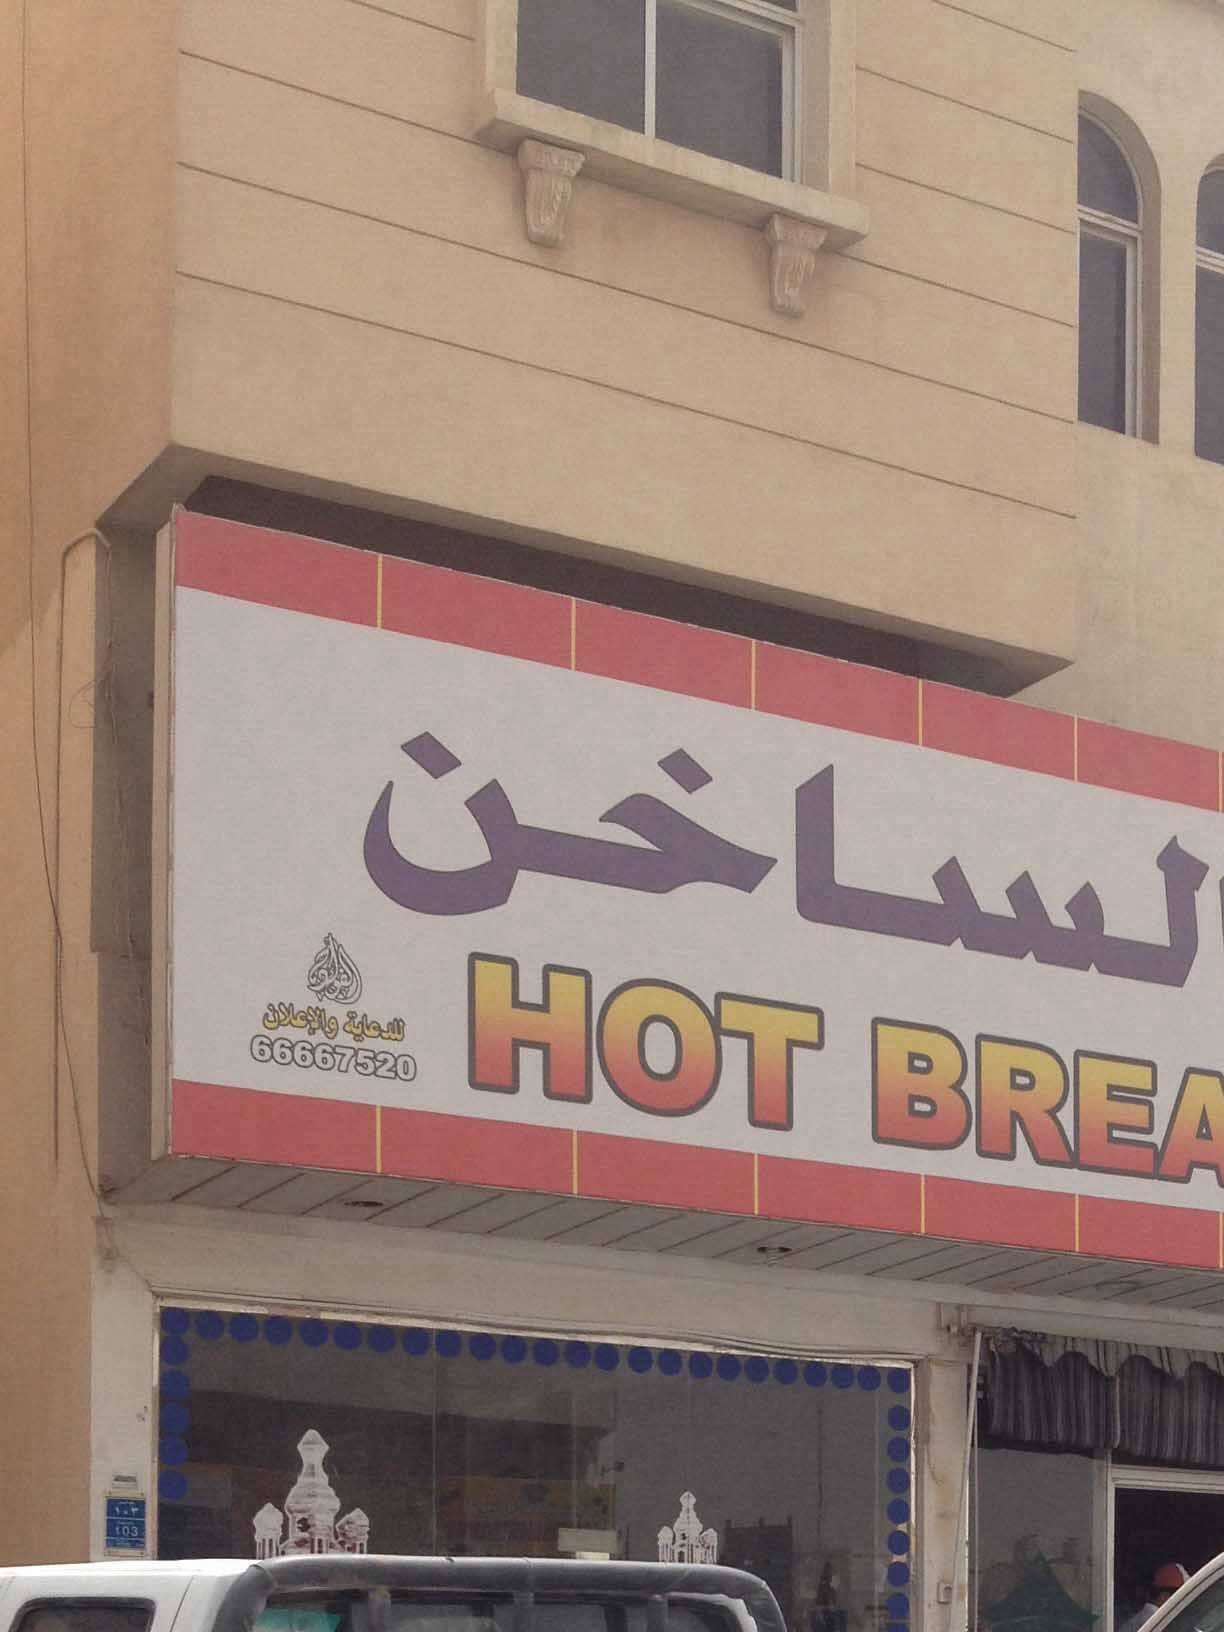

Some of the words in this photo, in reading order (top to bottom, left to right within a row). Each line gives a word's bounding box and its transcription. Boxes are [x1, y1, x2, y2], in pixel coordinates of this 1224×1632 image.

[343, 1010, 406, 1042] للدعاية
[467, 951, 824, 1131] HOT
[250, 1034, 417, 1081] 66667520
